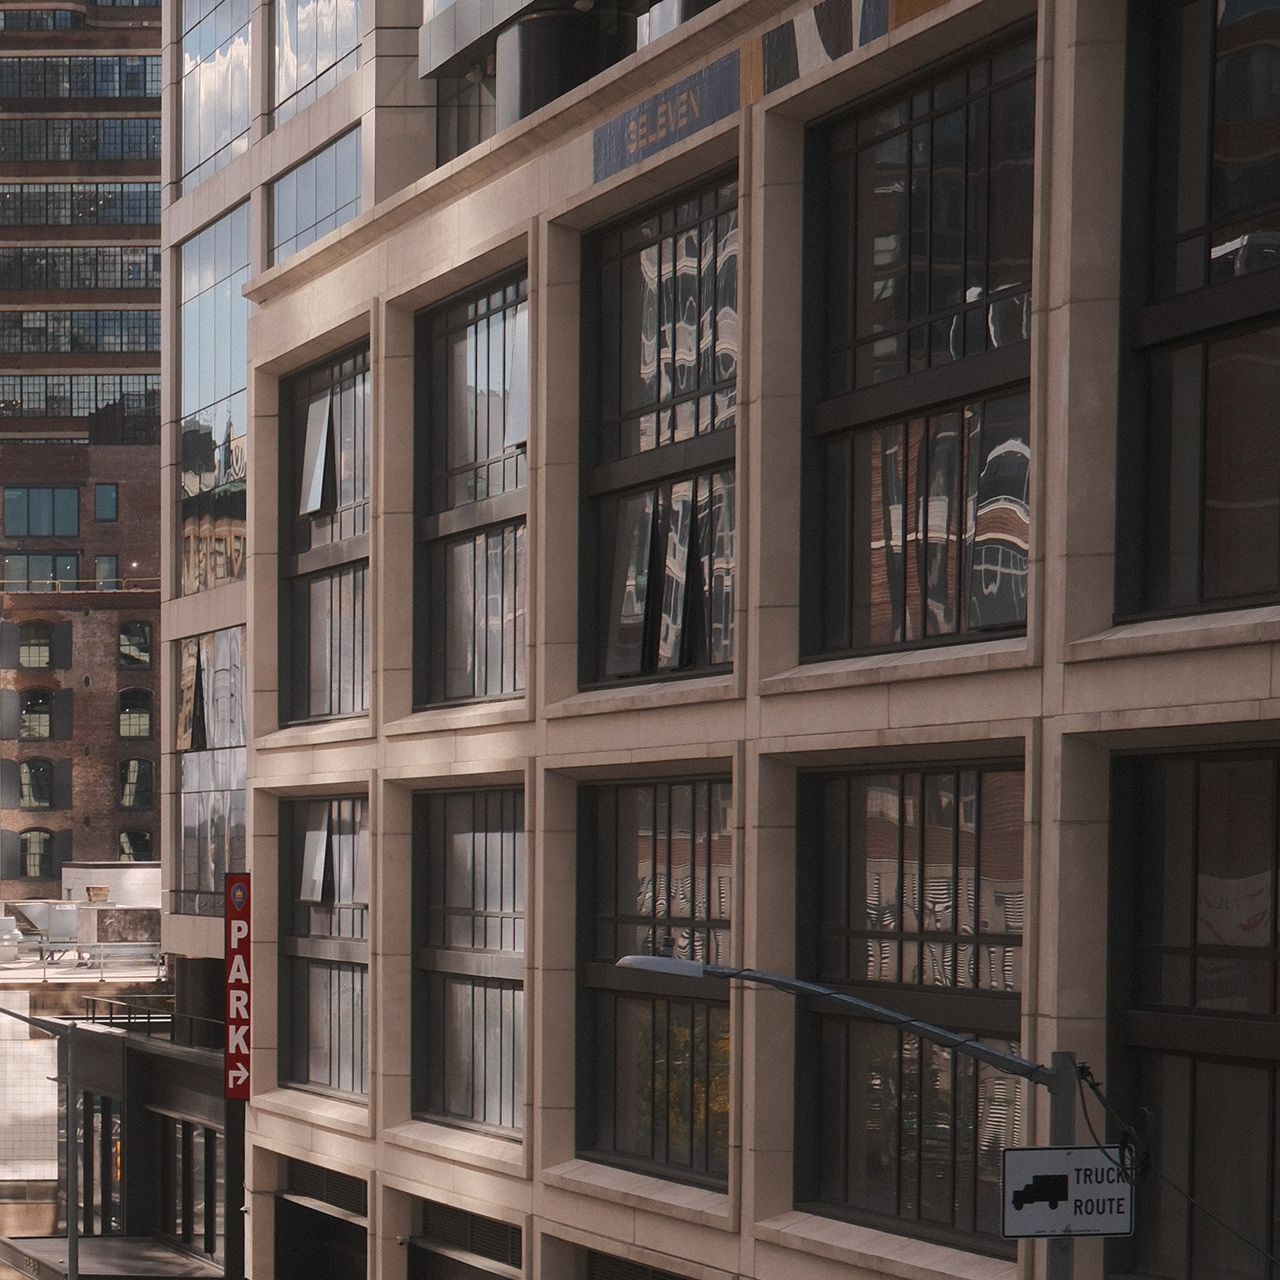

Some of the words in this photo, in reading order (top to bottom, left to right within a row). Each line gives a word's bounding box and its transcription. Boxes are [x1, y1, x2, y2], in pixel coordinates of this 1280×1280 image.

[228, 920, 250, 1054] PARK
[1074, 1167, 1127, 1185] TRUCK
[1073, 1198, 1126, 1216] ROUTE
